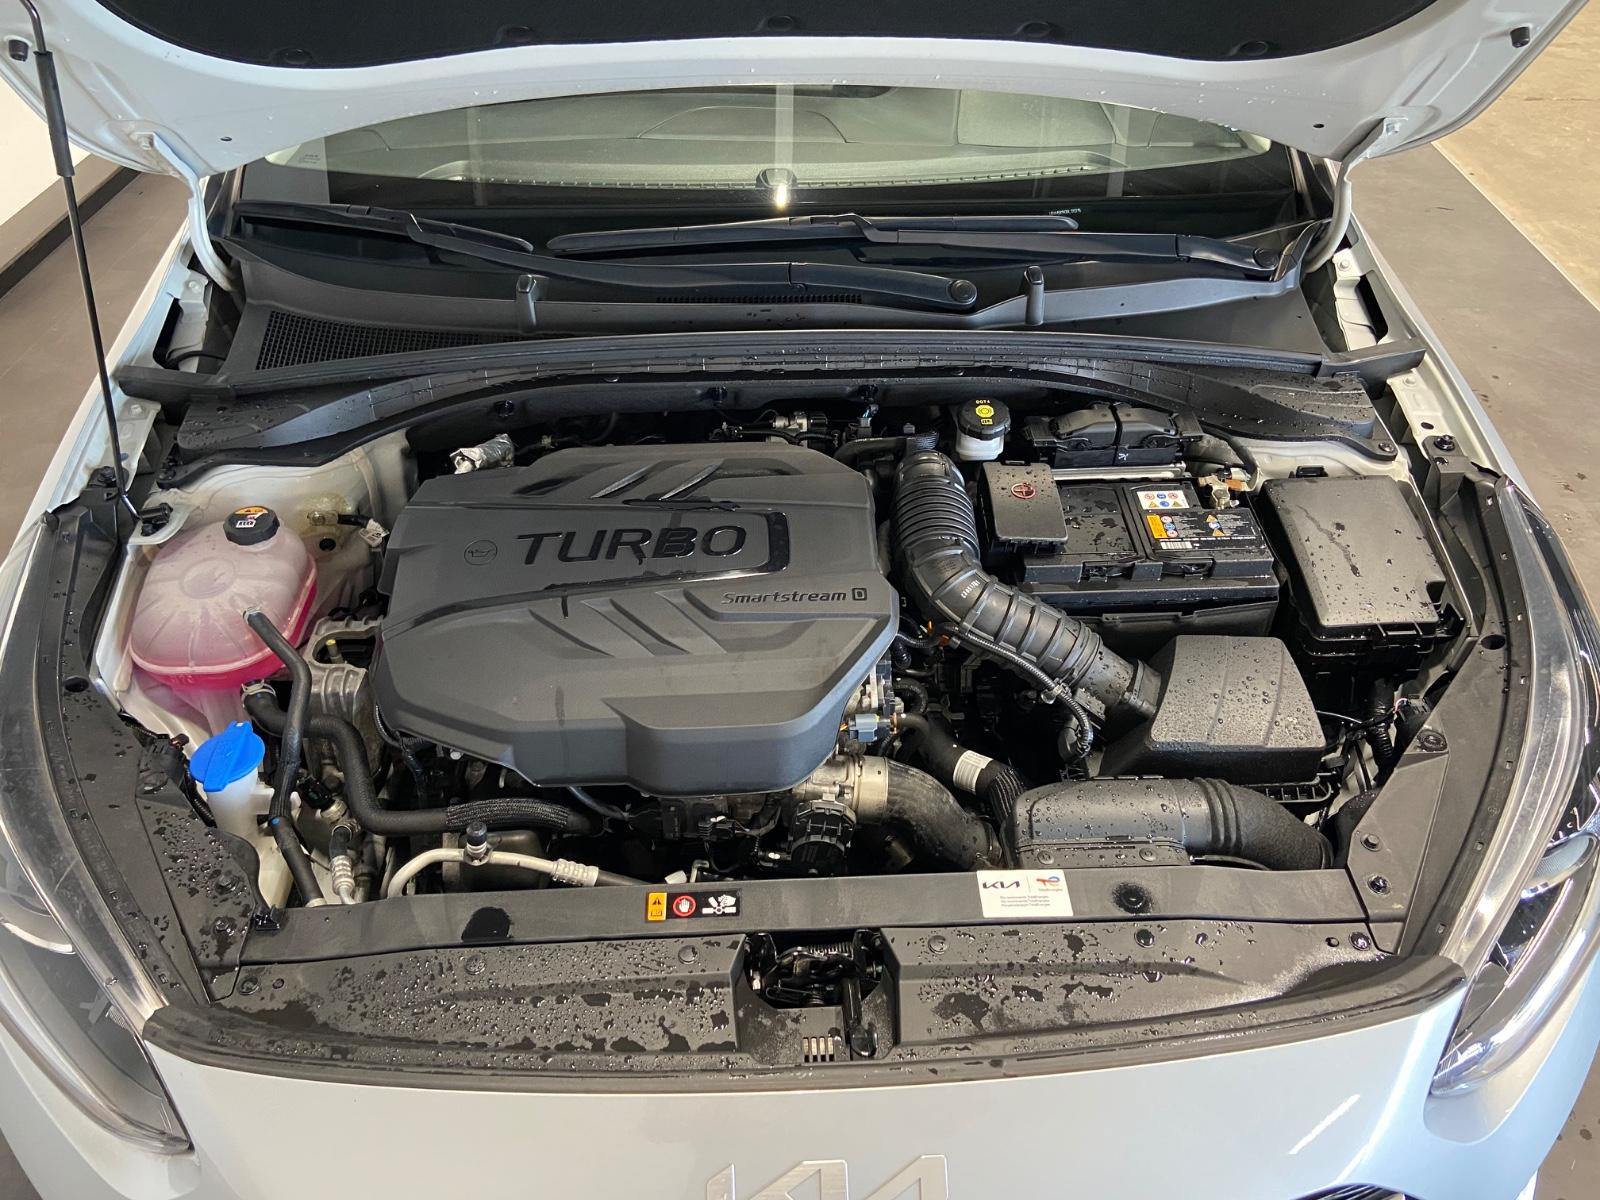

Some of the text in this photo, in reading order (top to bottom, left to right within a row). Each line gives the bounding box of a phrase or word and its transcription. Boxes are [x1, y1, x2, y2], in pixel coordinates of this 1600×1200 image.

[516, 525, 747, 565] TURBO
[721, 590, 847, 605] Smartstream
[982, 880, 1020, 889] KIA
